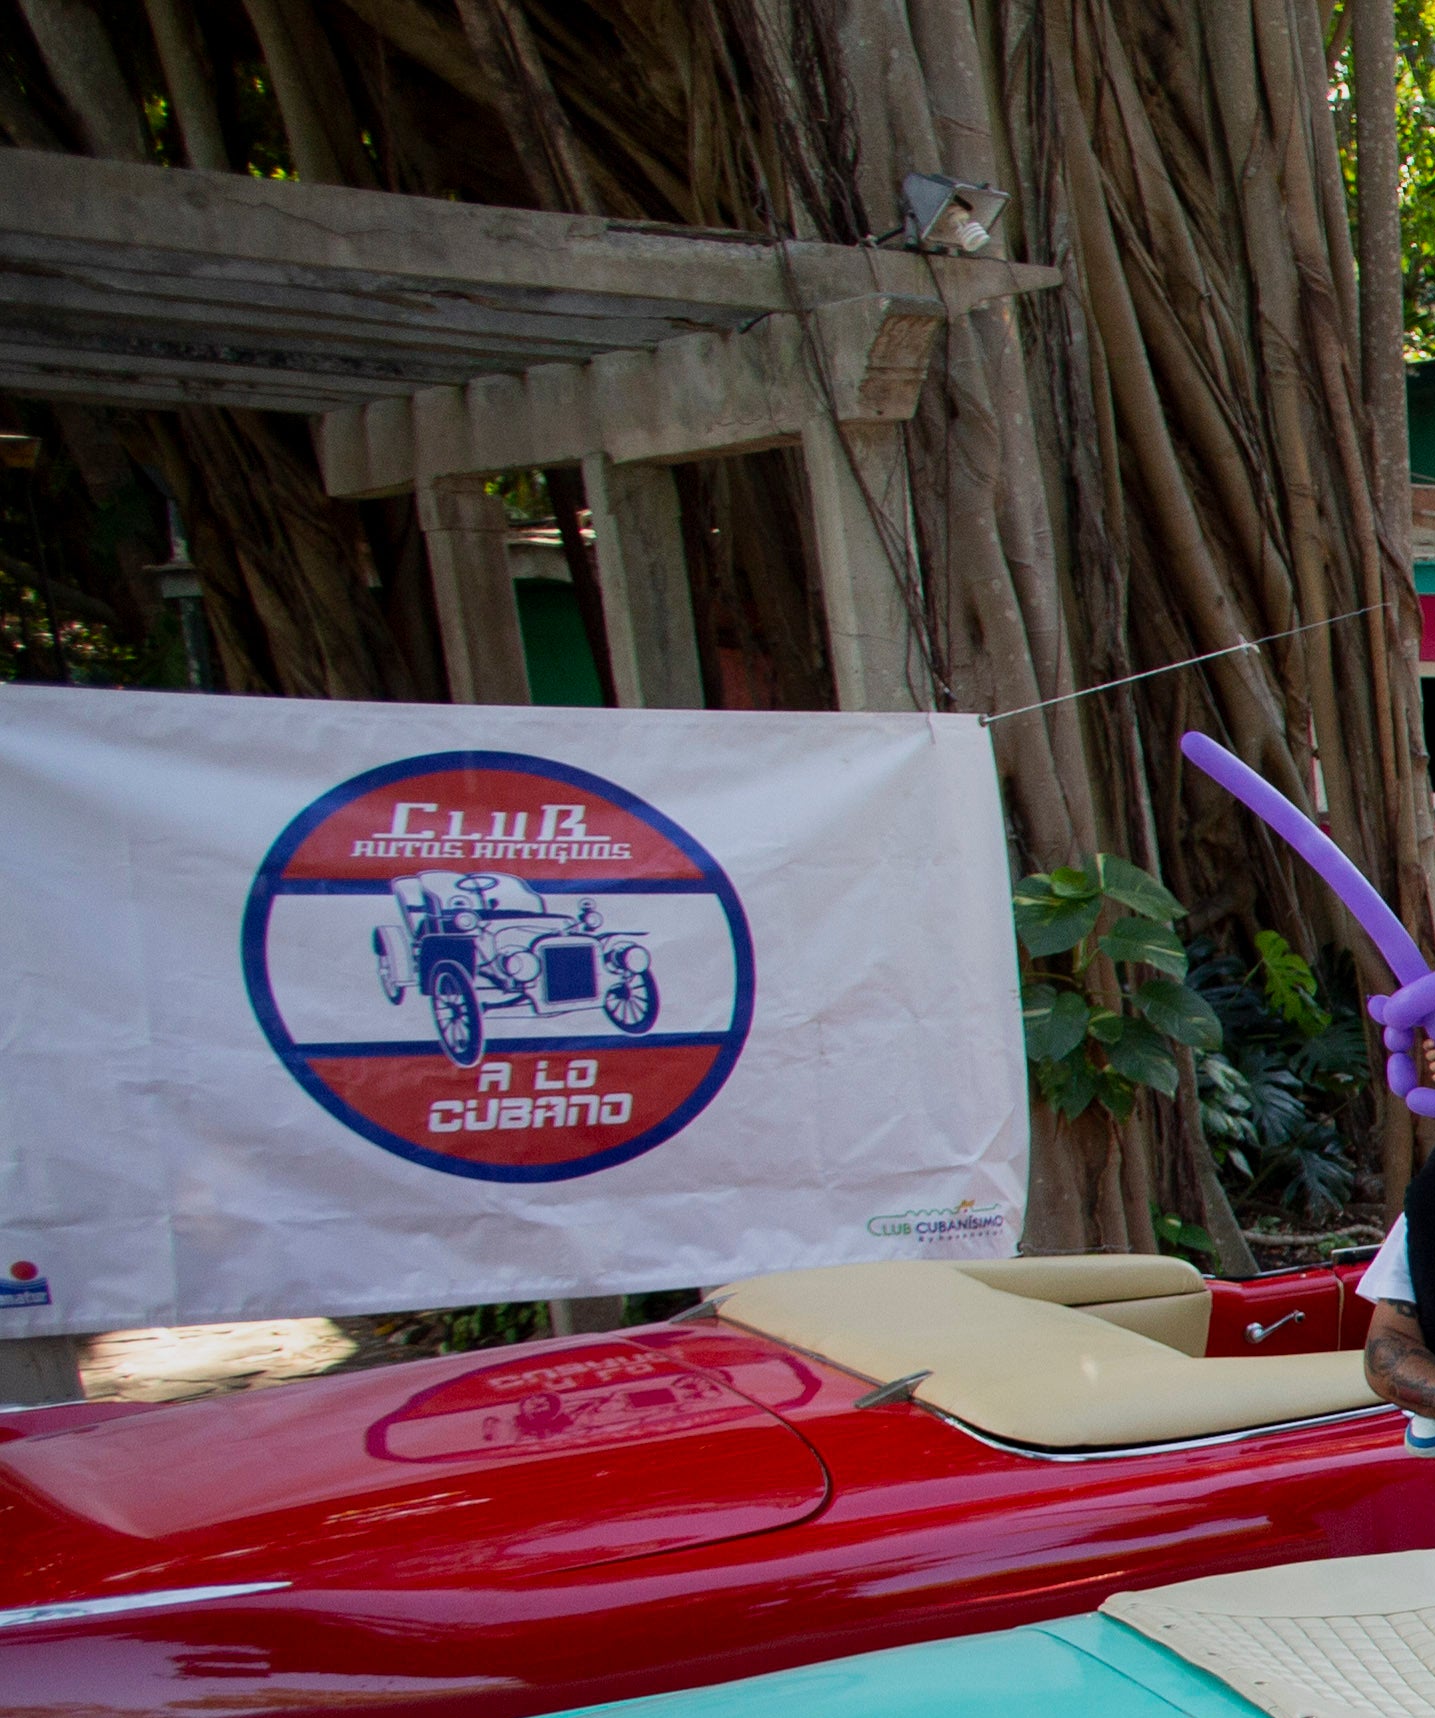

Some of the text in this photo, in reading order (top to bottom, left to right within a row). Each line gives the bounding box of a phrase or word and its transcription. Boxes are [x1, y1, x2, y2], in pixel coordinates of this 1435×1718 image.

[350, 840, 632, 864] AUTOS ANTIGUOS
[477, 1059, 598, 1092] A LO
[428, 1093, 634, 1133] CUBANO
